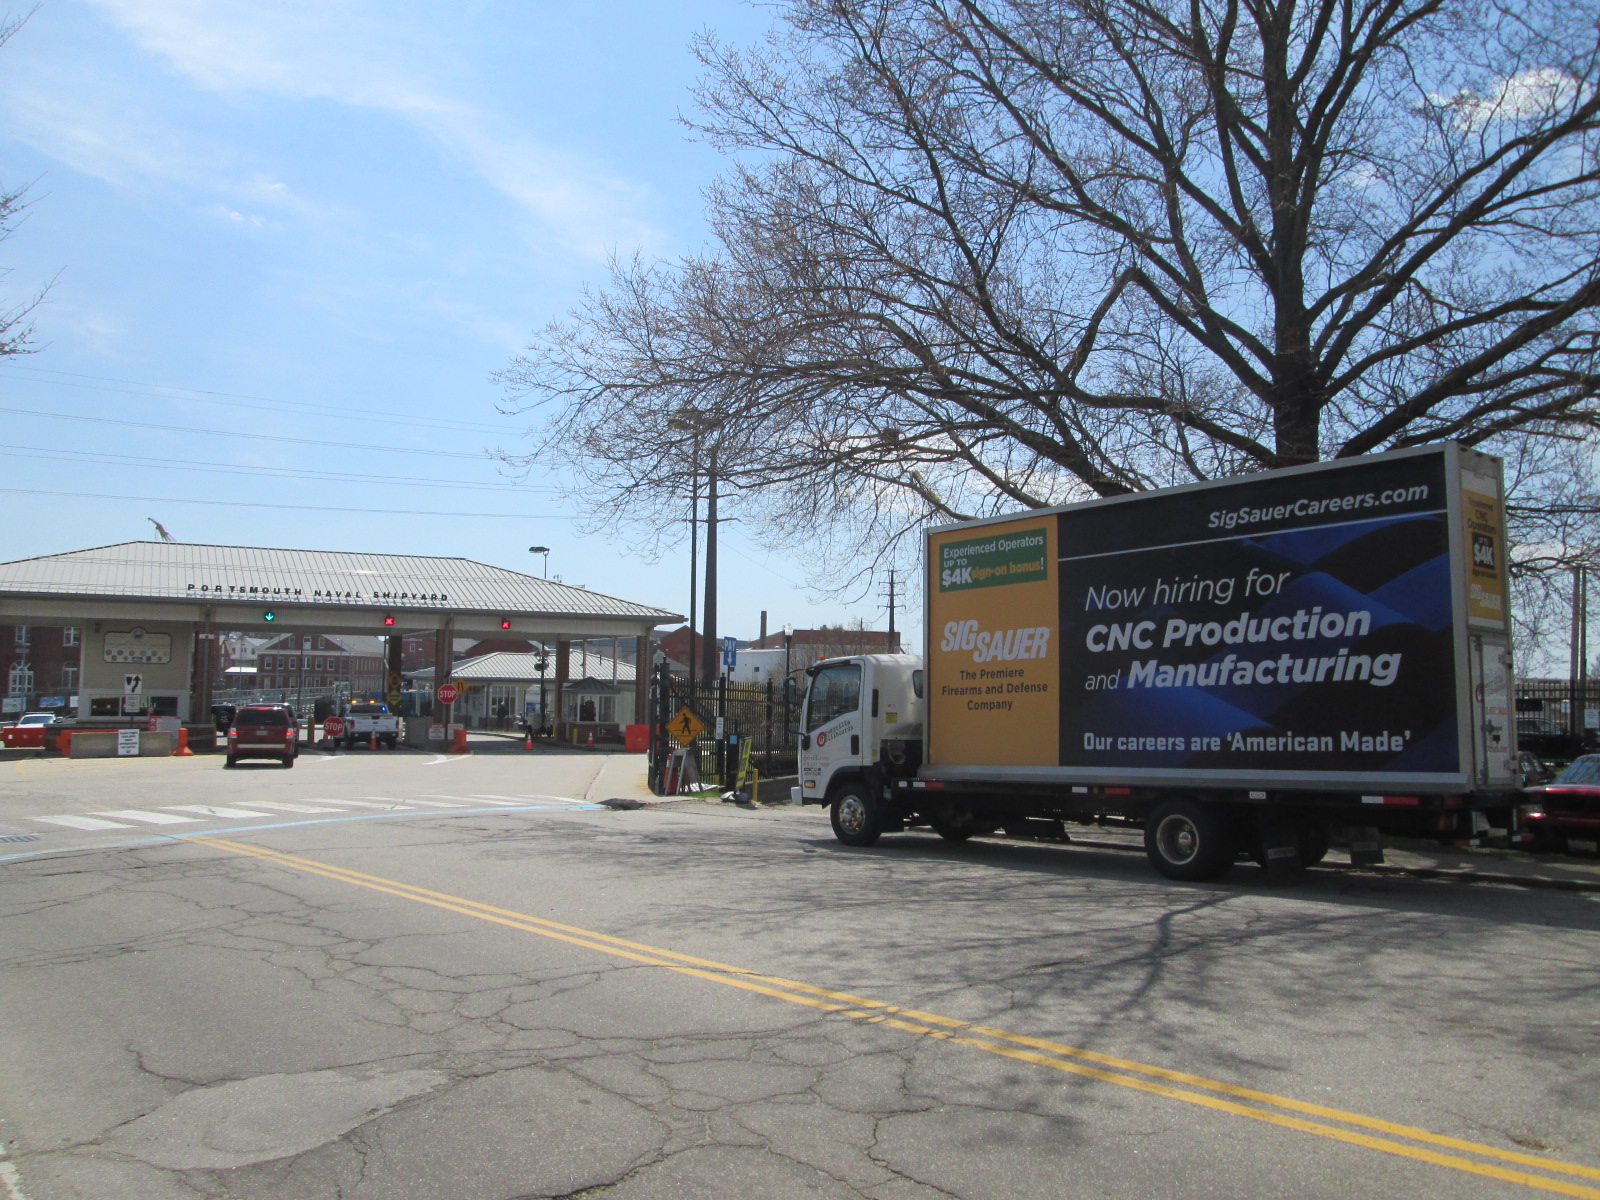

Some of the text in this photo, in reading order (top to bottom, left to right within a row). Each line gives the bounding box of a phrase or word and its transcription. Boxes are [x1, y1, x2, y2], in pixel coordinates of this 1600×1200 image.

[1208, 484, 1428, 529] SigSauerCareers.com
[943, 534, 1044, 559] Experienced Operators
[1473, 542, 1494, 566] $4K
[943, 558, 968, 568] UP TO
[941, 566, 973, 588] $4K
[971, 565, 1007, 581] sign-on
[187, 583, 448, 601] PORTSMOUTH NAVAL SHIPYARD
[1085, 568, 1291, 611] Now hiring for
[1085, 606, 1372, 653] CNC Production
[724, 639, 736, 651] PAY
[941, 619, 1051, 664] SIG SAUER
[959, 667, 1025, 680] The Premiere
[1085, 648, 1402, 691] and Manufacturing
[439, 690, 456, 698] STOP
[941, 681, 1048, 697] Firearms and Defense
[967, 699, 1013, 712] Company
[324, 722, 343, 731] STOP
[1083, 732, 1114, 752] Our
[1117, 734, 1186, 752] careers
[1190, 736, 1221, 752] are
